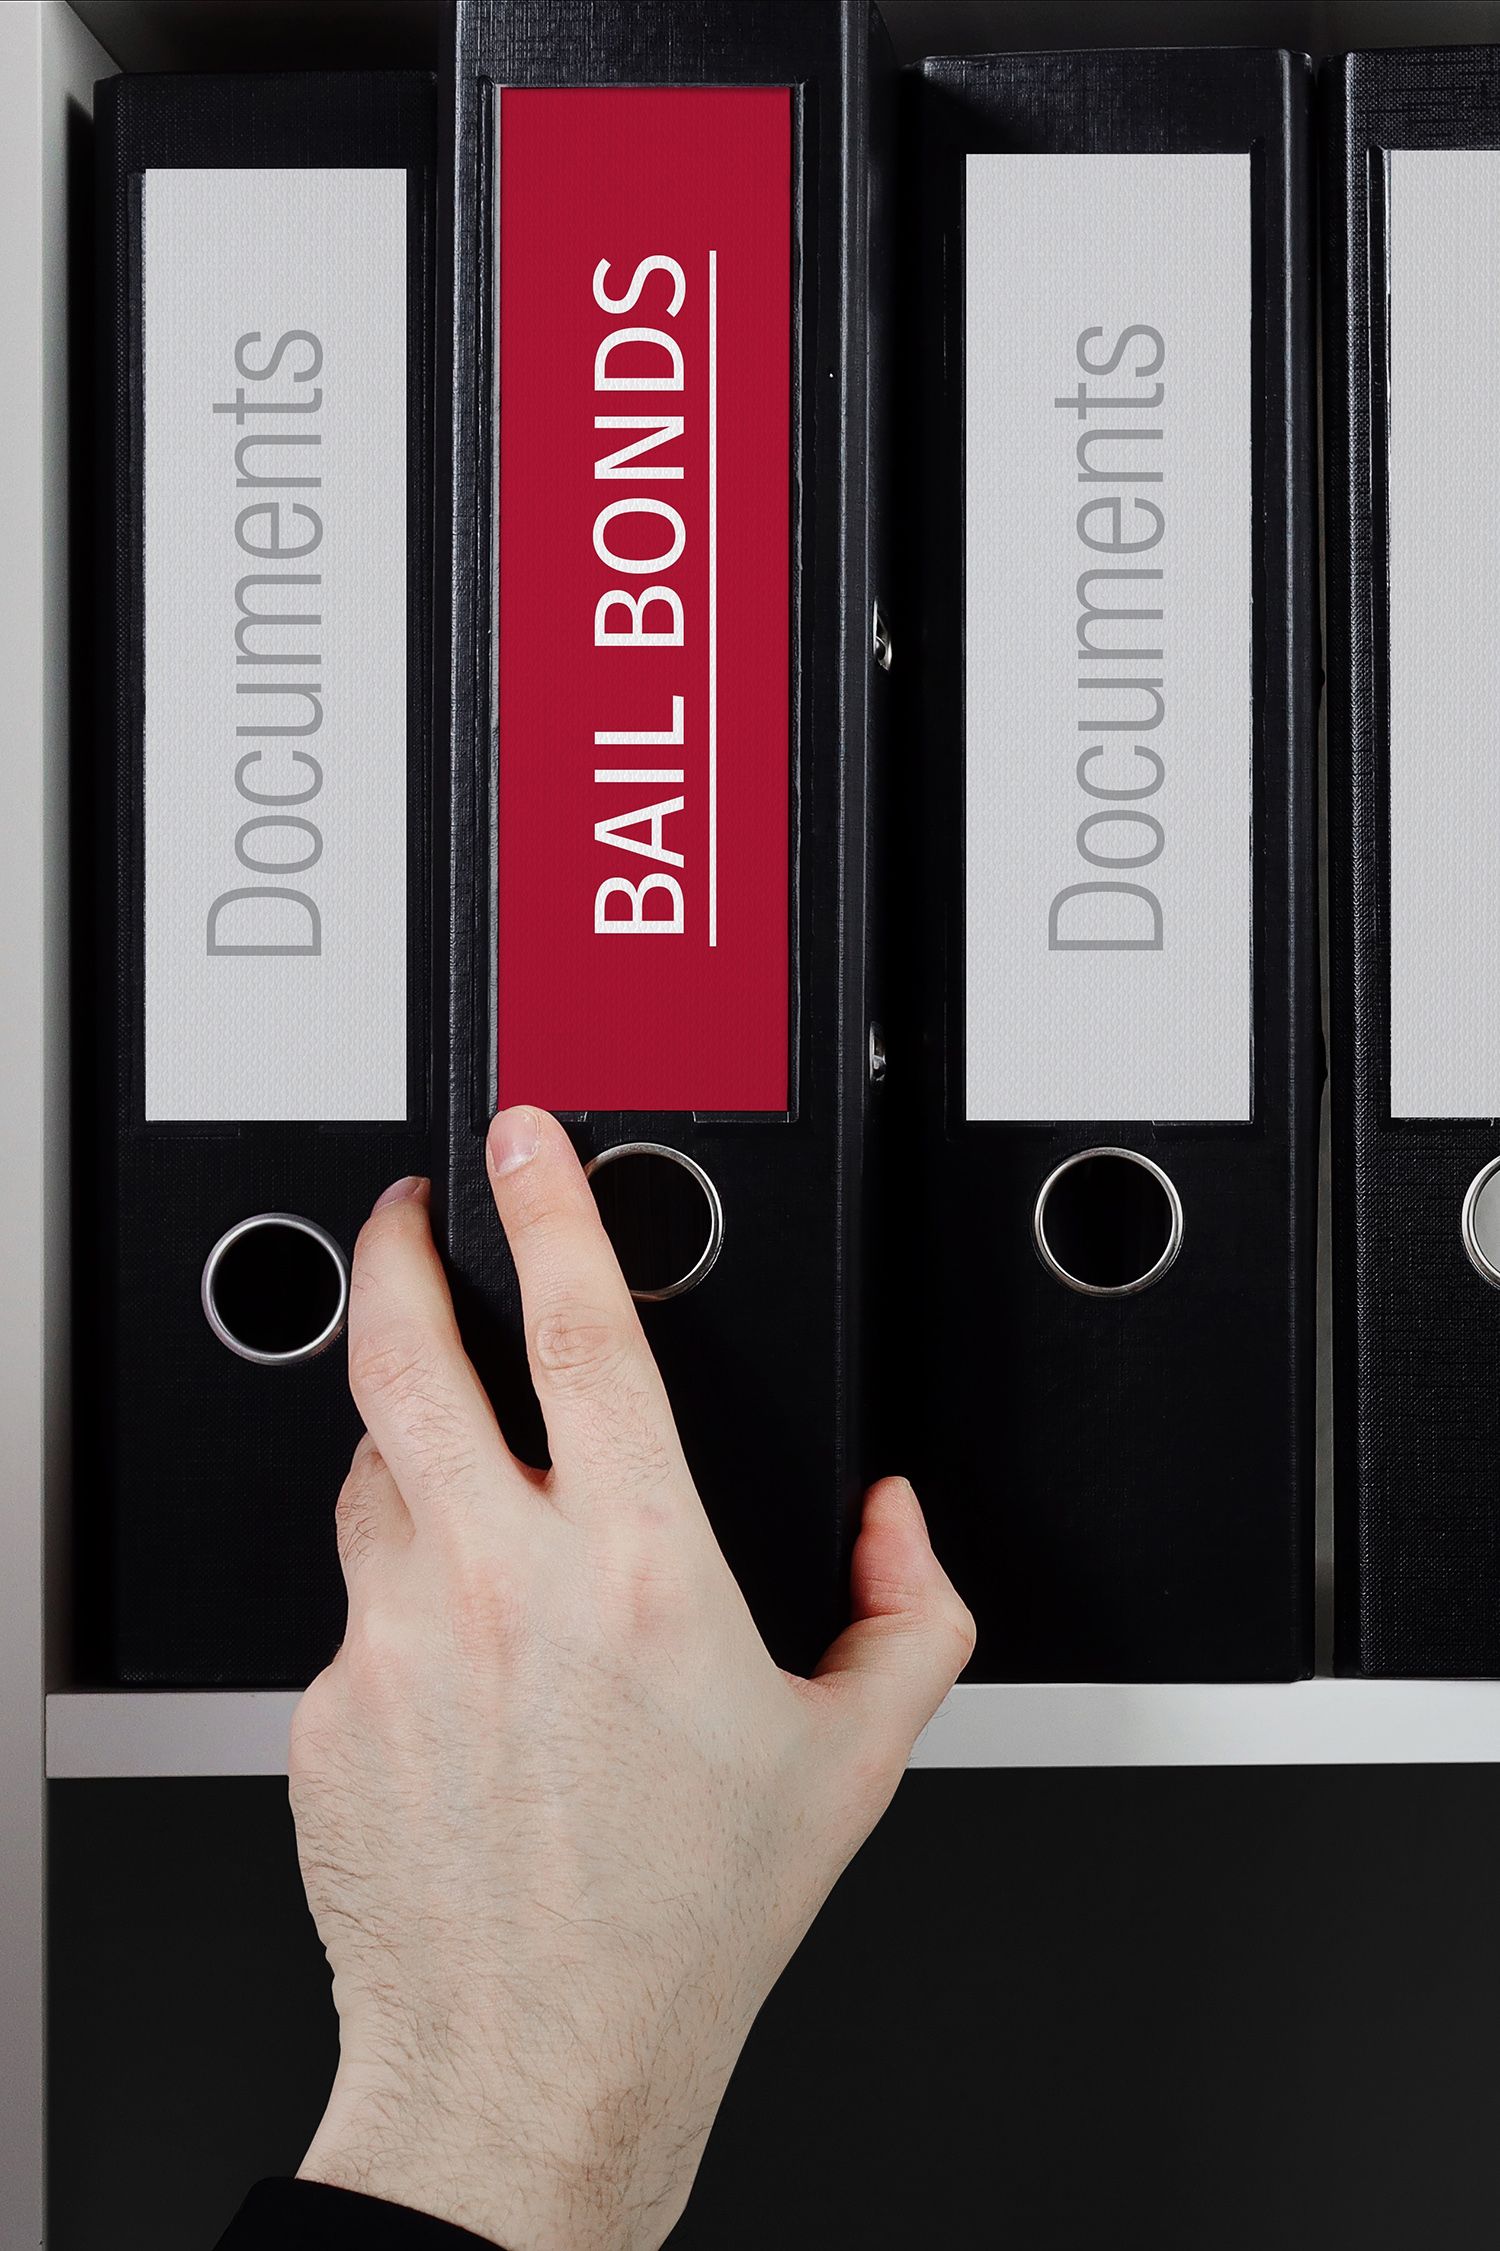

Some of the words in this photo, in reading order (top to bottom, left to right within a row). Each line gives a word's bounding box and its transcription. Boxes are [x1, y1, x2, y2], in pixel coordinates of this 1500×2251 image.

[207, 329, 324, 957] Documents
[592, 254, 687, 647] BONDS
[1047, 323, 1166, 952] Documents
[594, 695, 686, 935] BAIL
